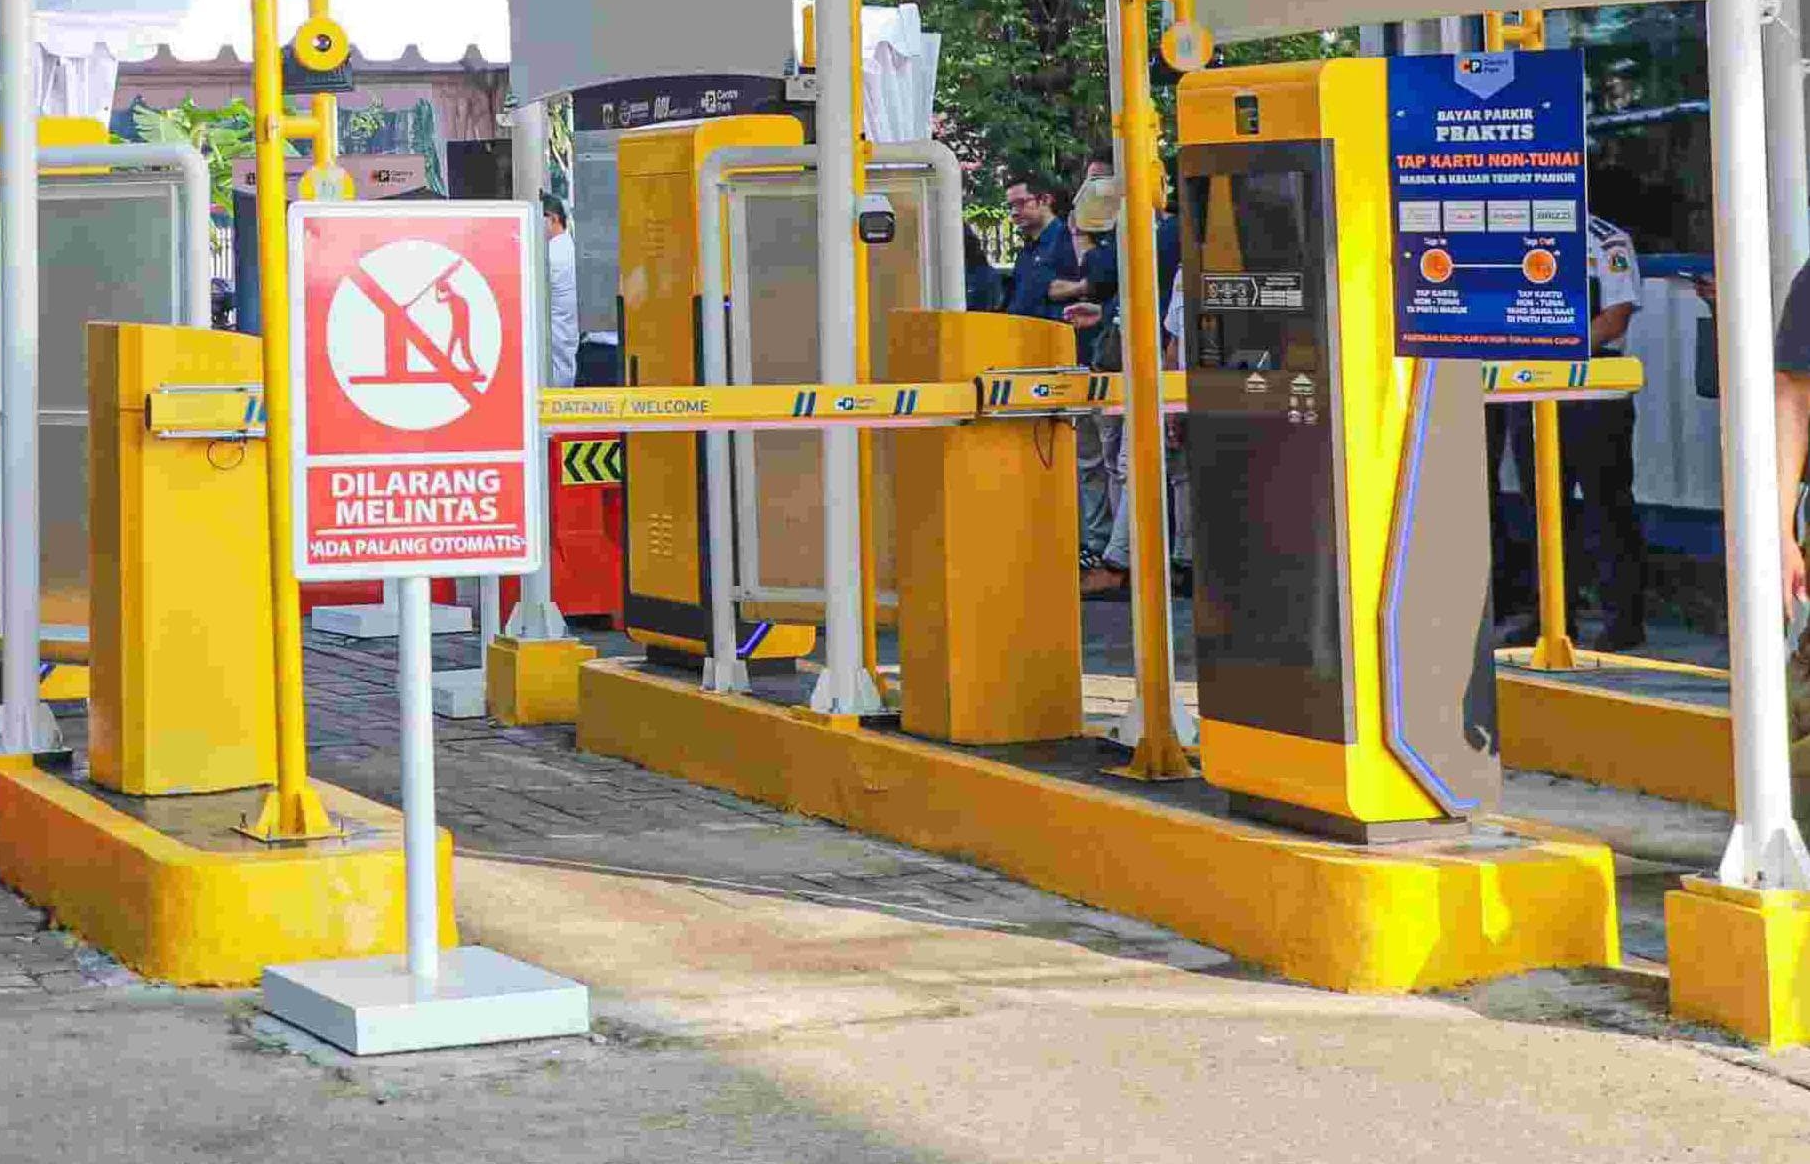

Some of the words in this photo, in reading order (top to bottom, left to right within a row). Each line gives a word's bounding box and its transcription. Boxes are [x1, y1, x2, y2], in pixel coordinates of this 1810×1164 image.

[1437, 109, 1482, 122] BAYAR
[1484, 108, 1534, 121] PARKIR
[1435, 124, 1535, 142] PRAKTIS
[1396, 154, 1426, 169] TAP
[1430, 154, 1484, 168] KARTU
[1488, 151, 1580, 168] NON-TUNAI
[551, 400, 615, 414] DATANG
[631, 399, 710, 414] WELCOME
[331, 468, 502, 498] DILARANG
[335, 496, 498, 526] MELINTAS
[355, 537, 428, 555] PALANG
